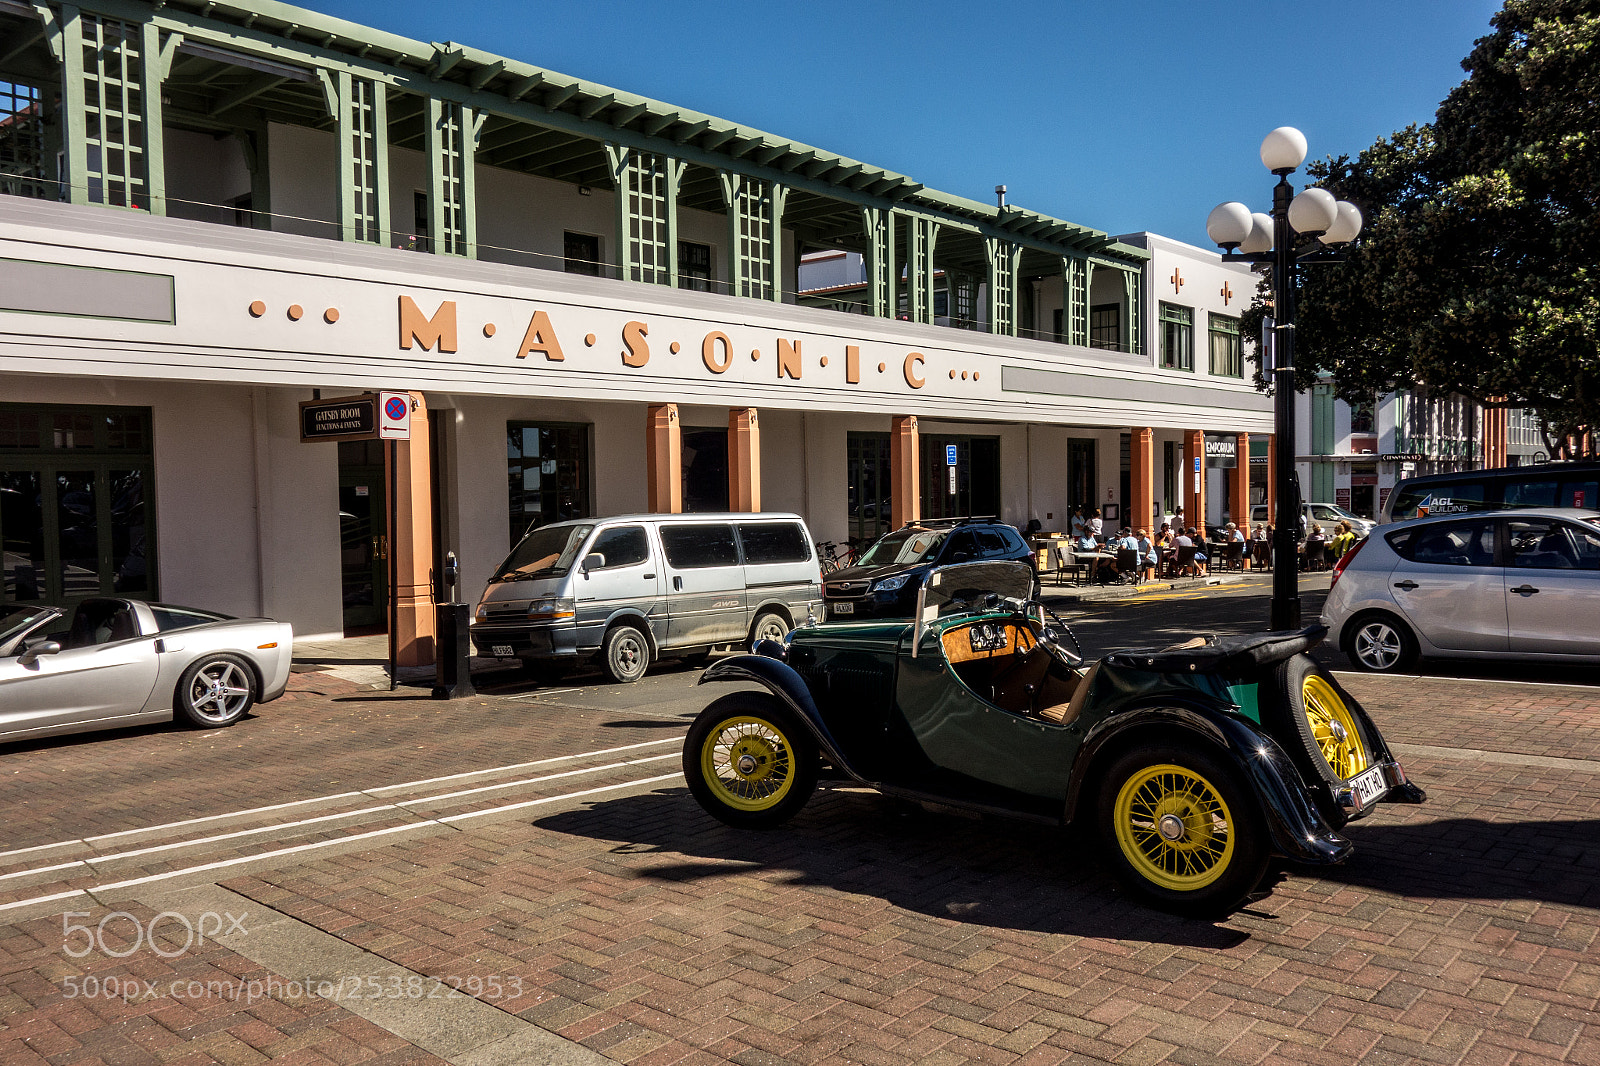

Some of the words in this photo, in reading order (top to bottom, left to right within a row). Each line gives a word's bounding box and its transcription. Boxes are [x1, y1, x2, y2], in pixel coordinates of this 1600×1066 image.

[315, 409, 339, 421] GATSBY
[340, 407, 361, 419] ROOM
[316, 422, 339, 431] FUNCTIONS
[344, 420, 361, 429] EVENTS
[1205, 441, 1235, 454] EMPORIUM
[1430, 497, 1454, 506] AGL
[1429, 505, 1468, 513] BUILDING
[711, 600, 740, 608] AWD
